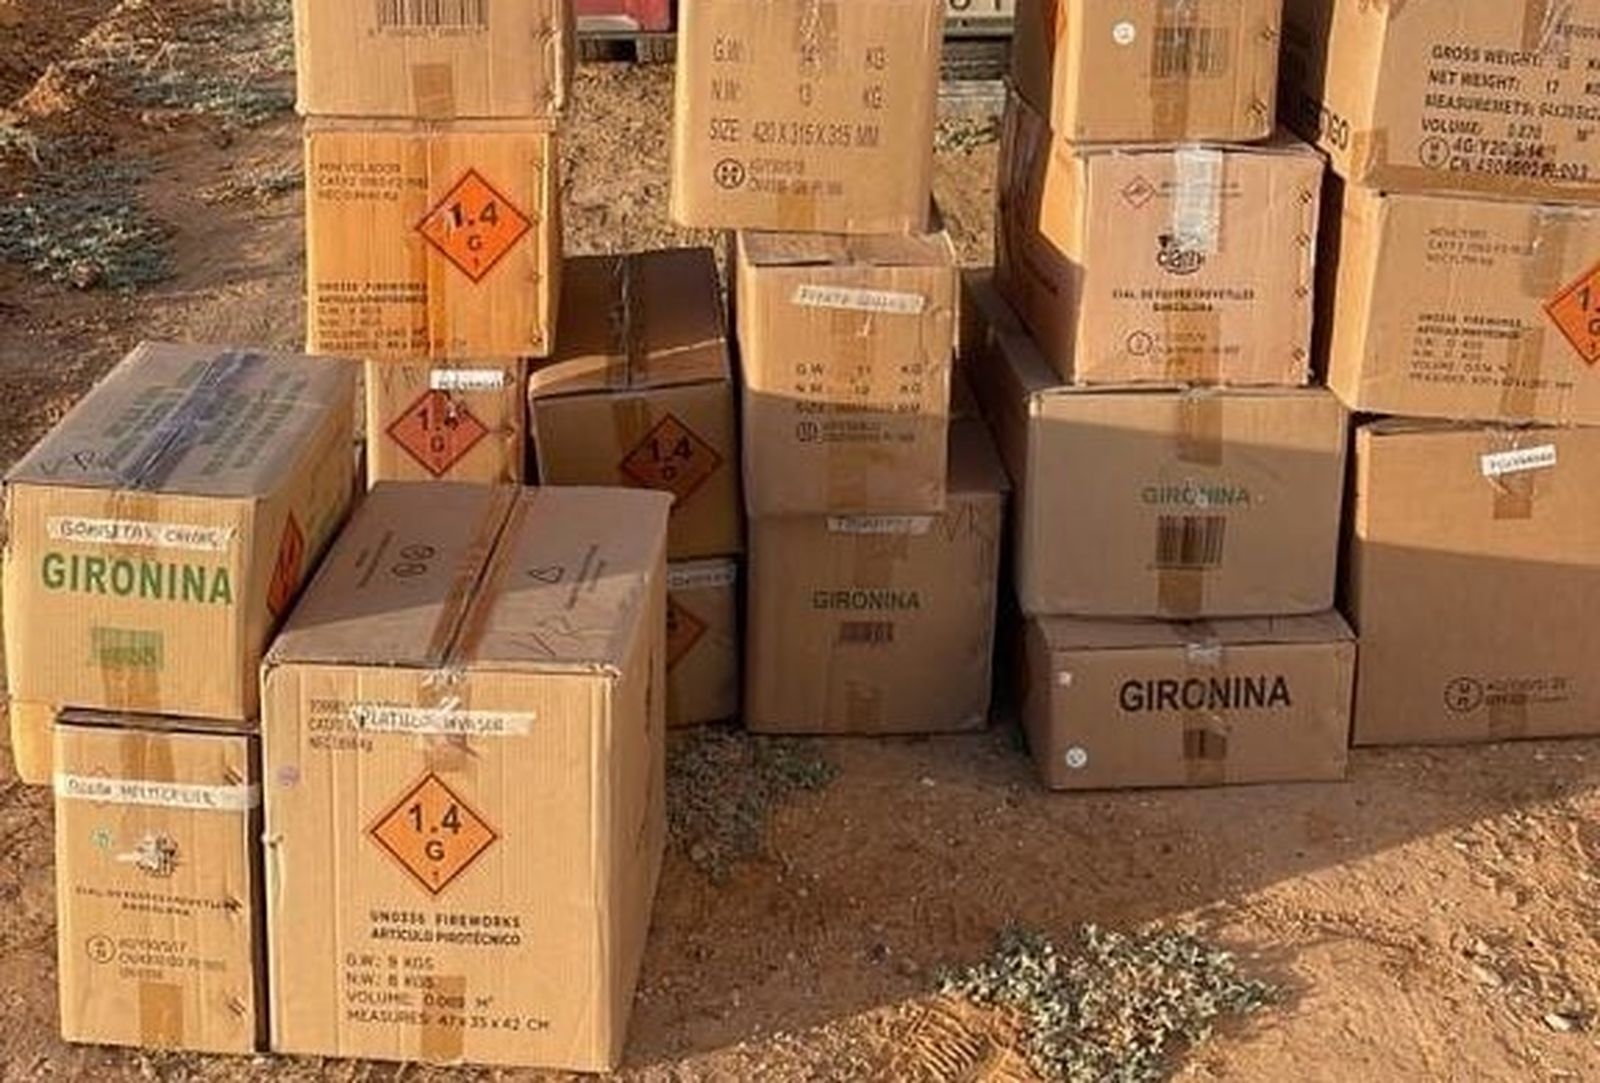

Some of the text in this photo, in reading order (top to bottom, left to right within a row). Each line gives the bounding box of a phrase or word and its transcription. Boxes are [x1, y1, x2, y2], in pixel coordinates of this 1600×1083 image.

[1432, 45, 1480, 62] GROSS
[1427, 70, 1455, 86] NET
[449, 201, 499, 228] 1.4
[468, 235, 482, 251] G
[651, 436, 694, 461] 1.4
[42, 552, 234, 605] GIRONINA
[812, 589, 921, 610] GIRONINA
[1118, 675, 1292, 712] GIRONINA
[407, 802, 463, 835] 1.4
[424, 840, 446, 862] G
[435, 912, 521, 929] FIREWORKS
